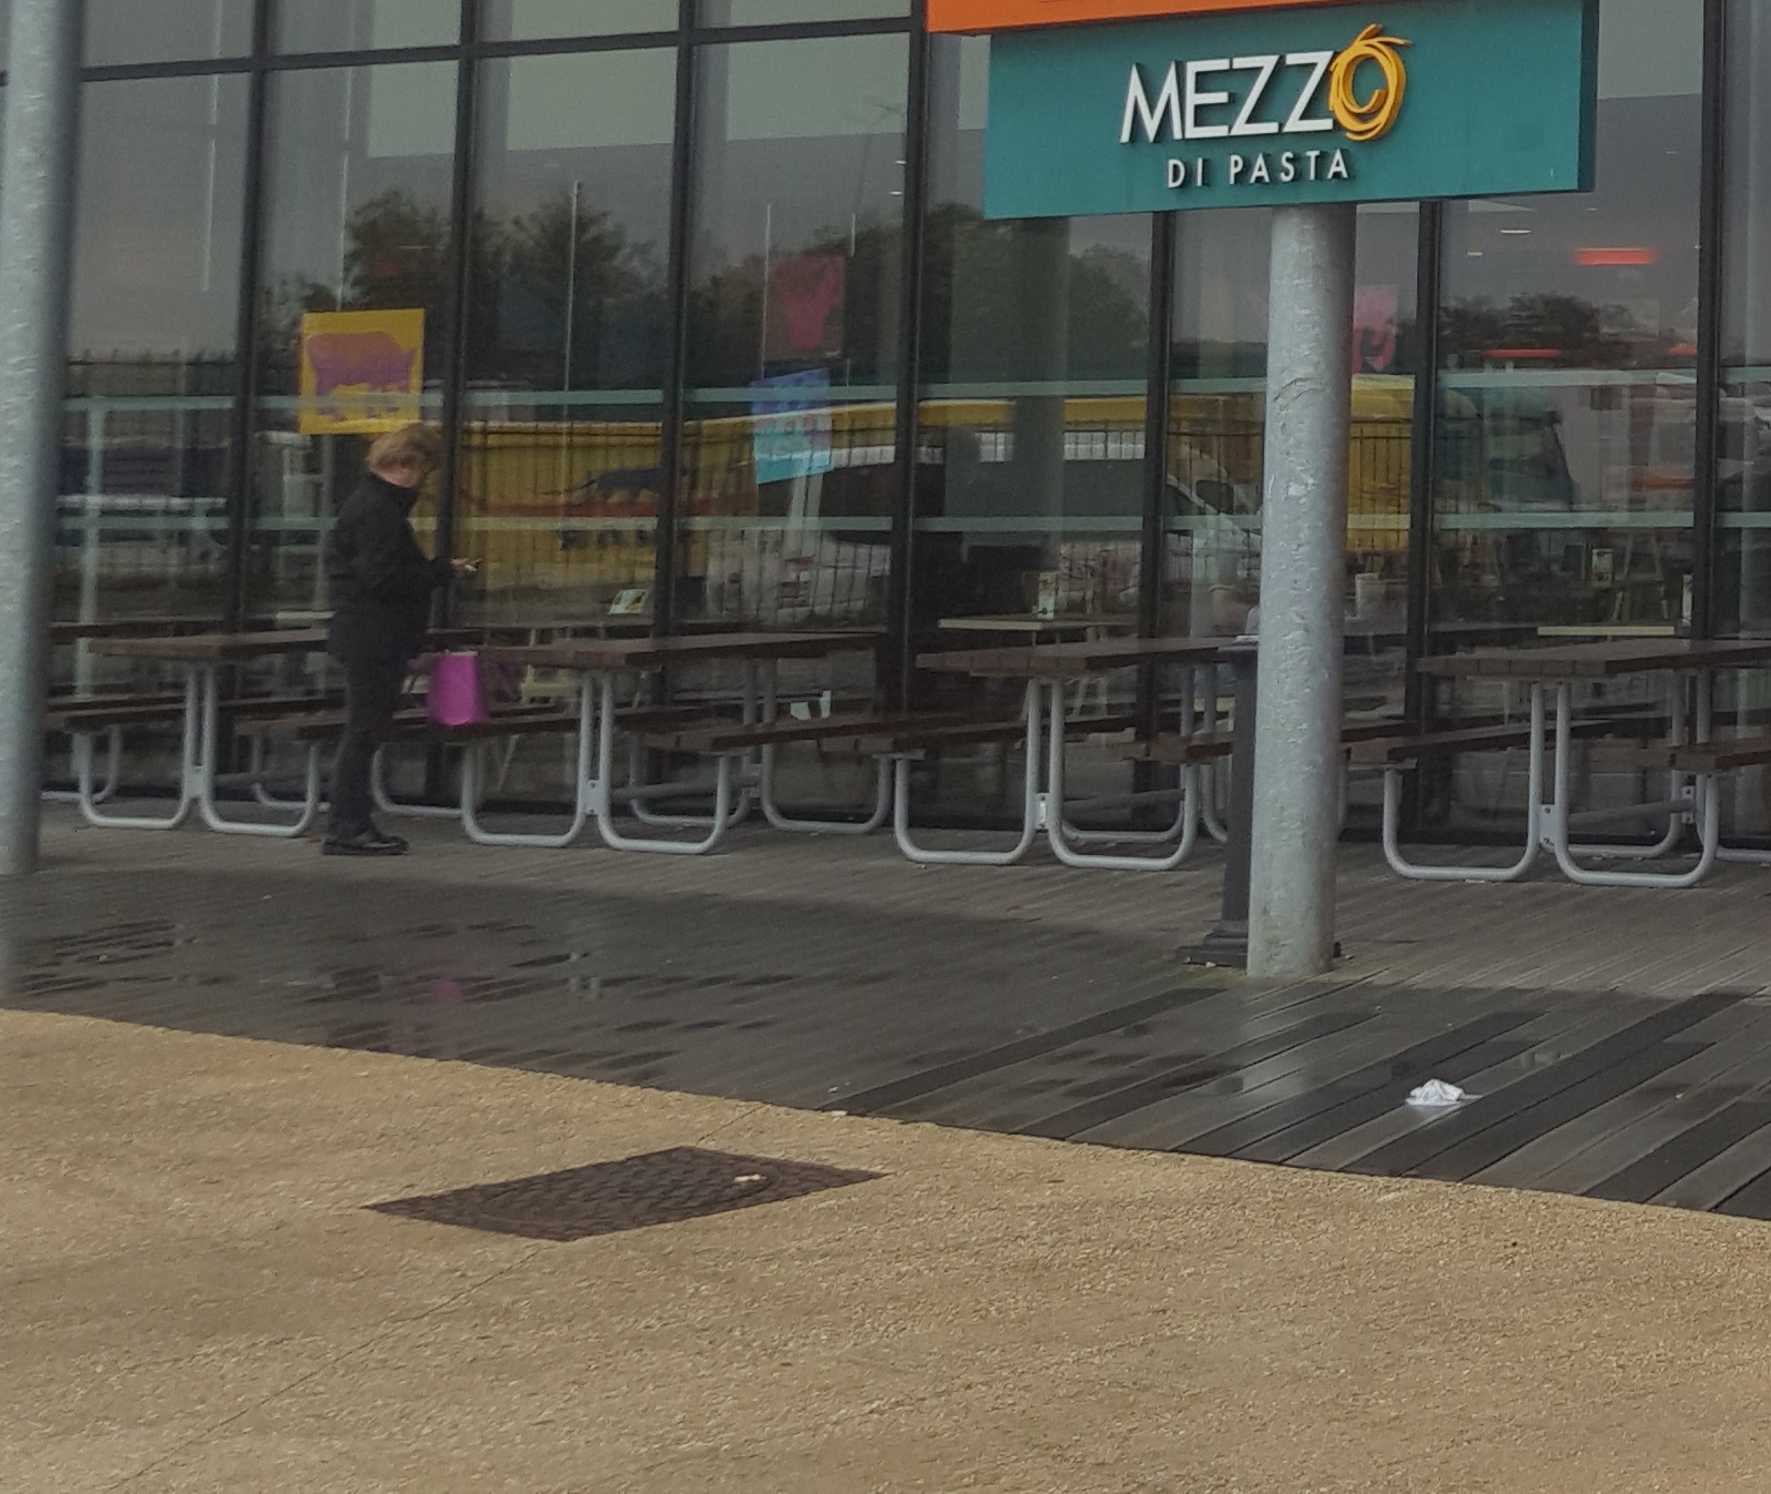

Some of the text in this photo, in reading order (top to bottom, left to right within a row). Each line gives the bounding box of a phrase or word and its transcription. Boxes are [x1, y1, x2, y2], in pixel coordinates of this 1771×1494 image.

[1119, 22, 1412, 144] MEZZO
[1167, 147, 1350, 189] DI PASTA
